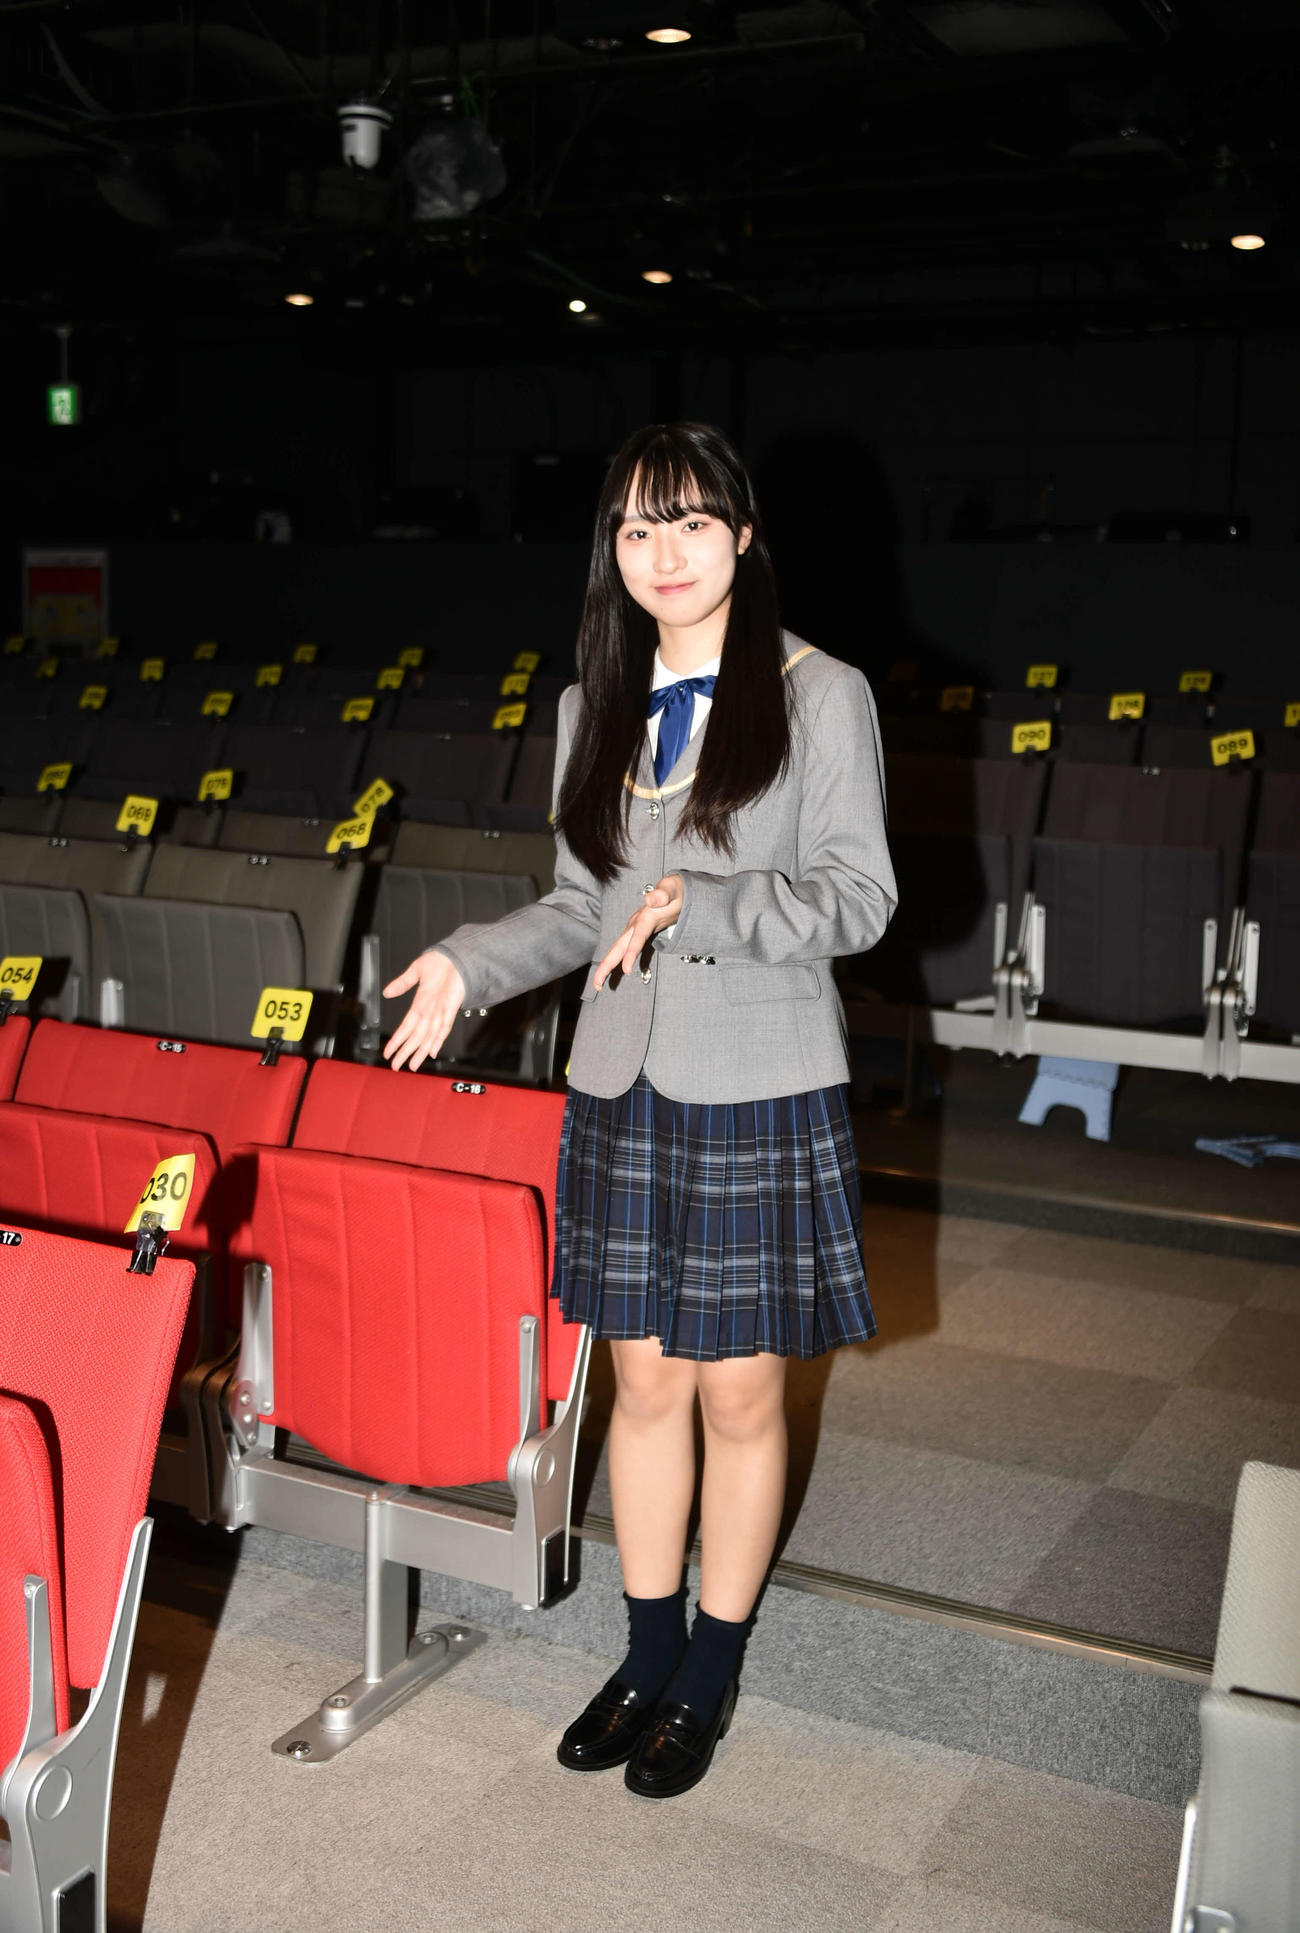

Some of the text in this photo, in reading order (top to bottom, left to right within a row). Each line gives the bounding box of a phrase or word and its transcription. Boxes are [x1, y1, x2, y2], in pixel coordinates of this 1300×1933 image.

[1018, 730, 1046, 742] 090
[1217, 738, 1248, 754] 089
[361, 787, 386, 813] 078
[126, 805, 153, 822] 069
[336, 822, 367, 840] 068
[1, 967, 34, 984] 054
[264, 1000, 303, 1021] 053
[160, 1041, 182, 1053] C-15
[456, 1083, 481, 1094] C-16
[140, 1172, 187, 1204] 030
[0, 1231, 16, 1245] 17
